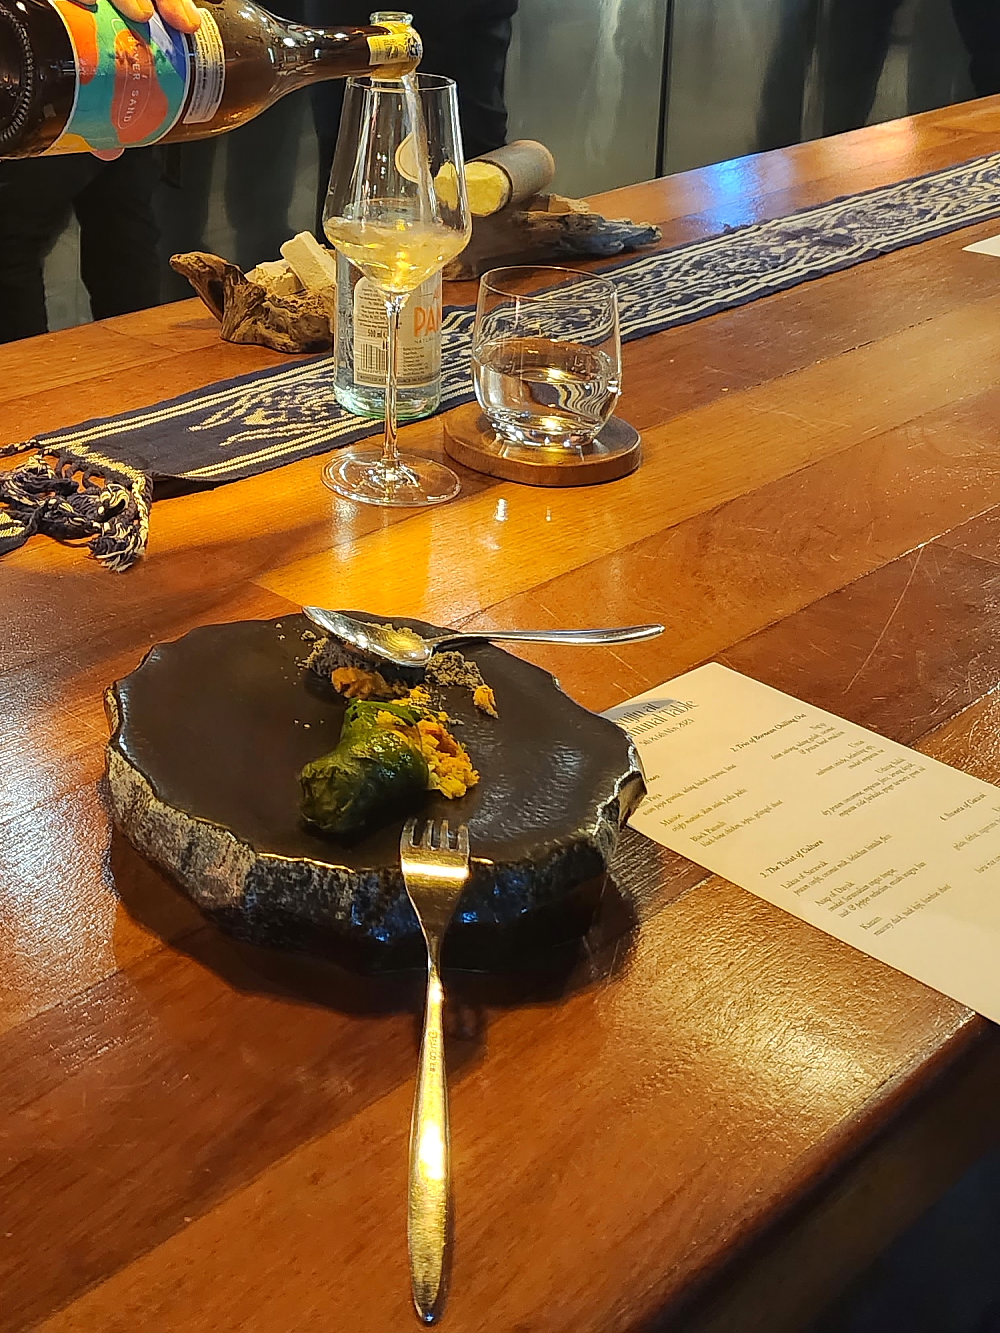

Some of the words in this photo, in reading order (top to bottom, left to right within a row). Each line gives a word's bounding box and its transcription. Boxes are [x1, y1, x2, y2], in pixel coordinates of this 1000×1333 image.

[123, 90, 139, 123] SAND
[663, 699, 700, 719] Table
[777, 856, 797, 867] Twist
[800, 840, 824, 853] Culture
